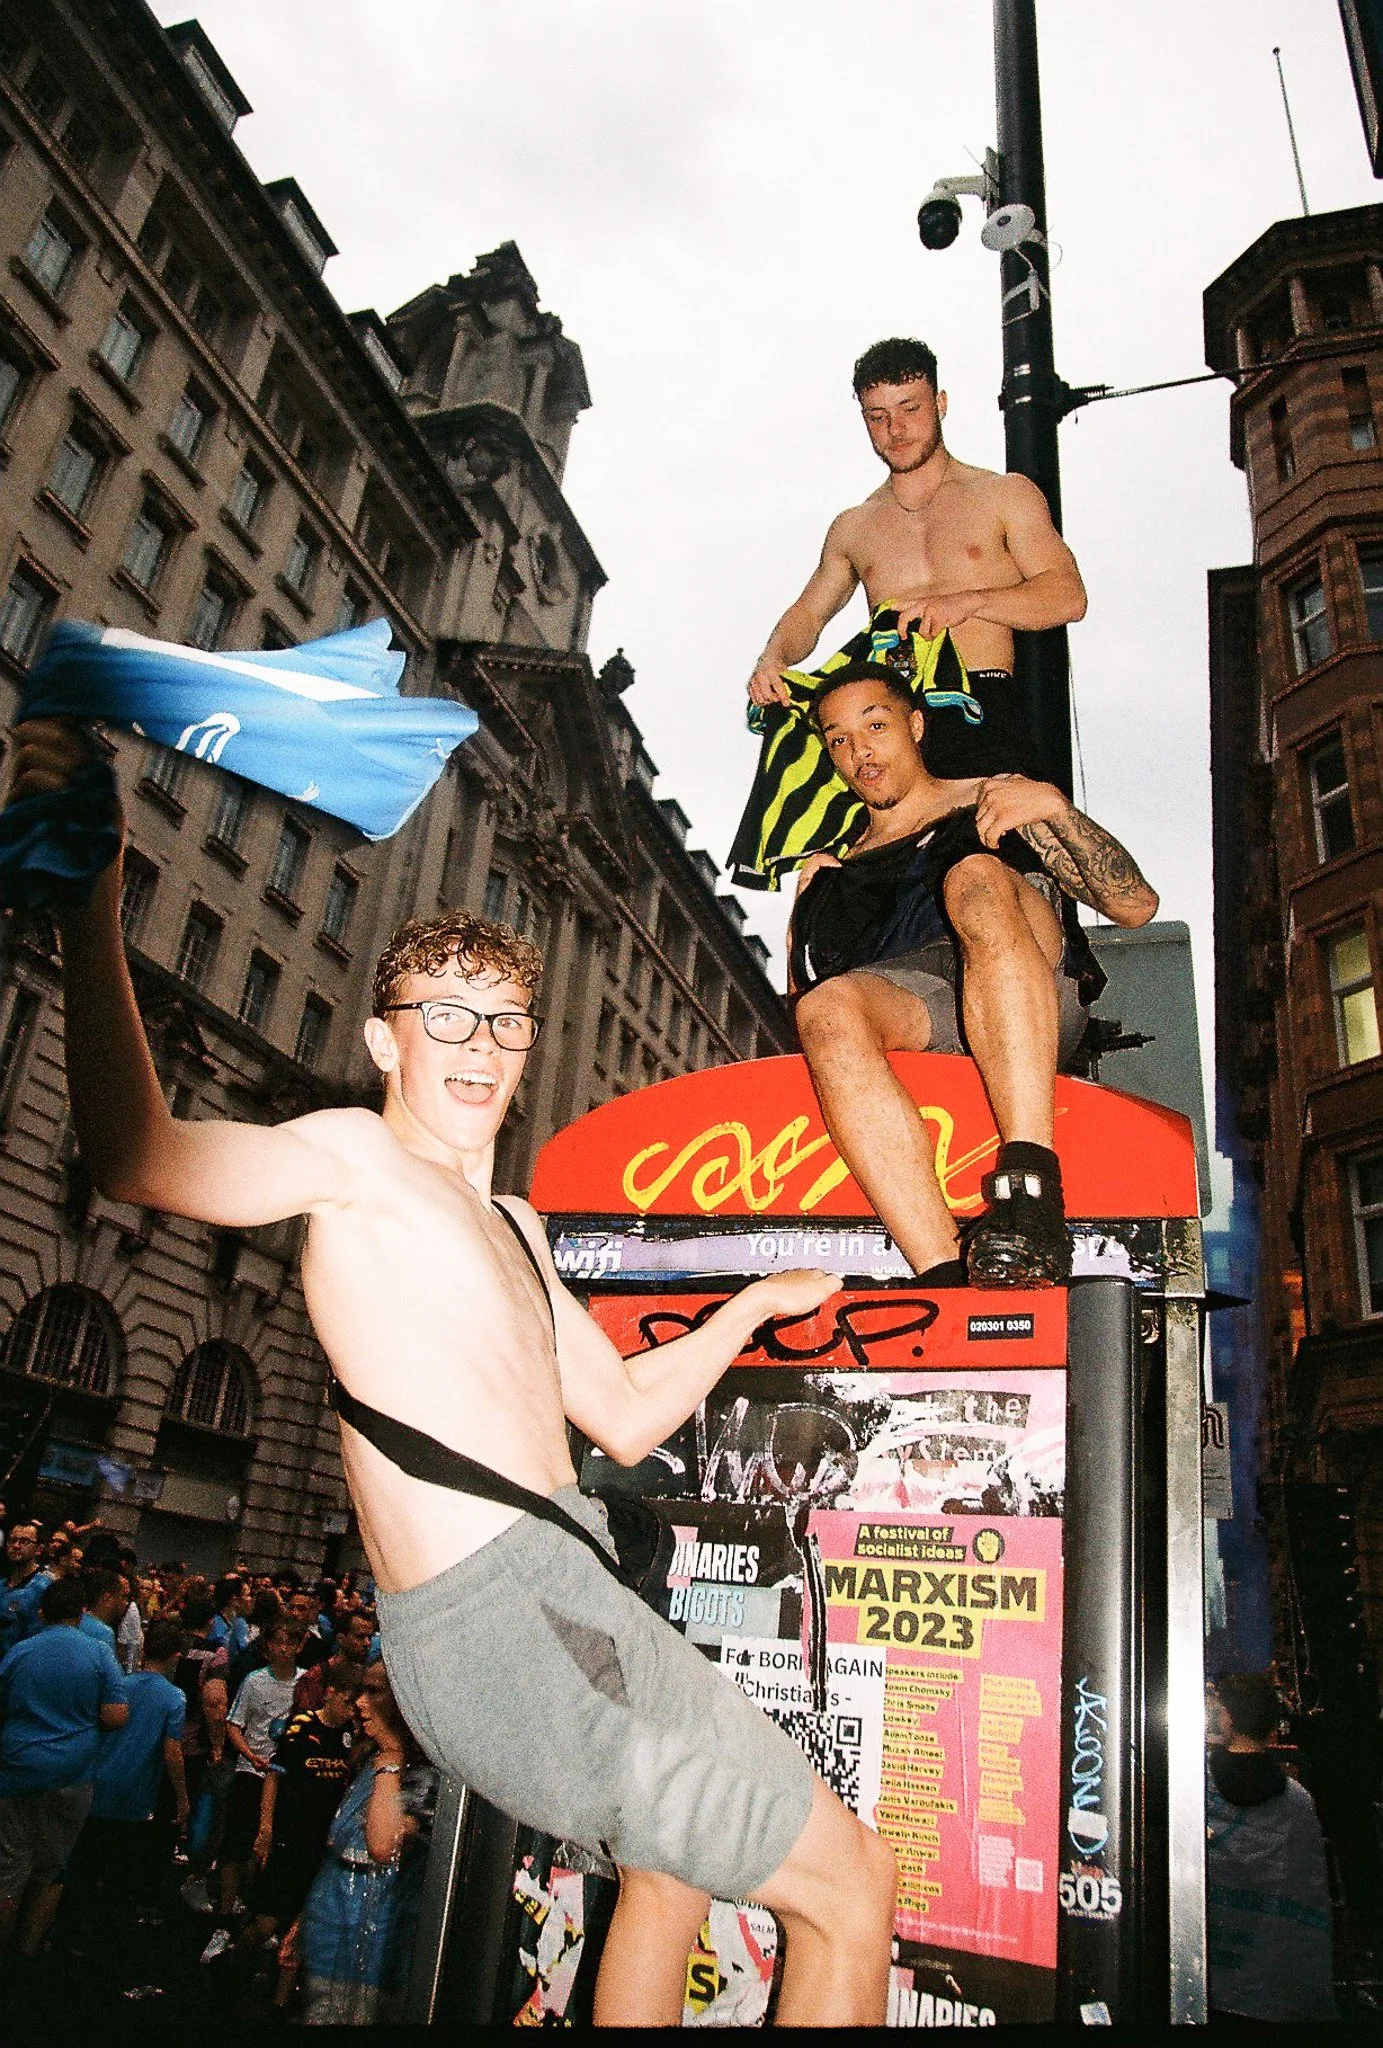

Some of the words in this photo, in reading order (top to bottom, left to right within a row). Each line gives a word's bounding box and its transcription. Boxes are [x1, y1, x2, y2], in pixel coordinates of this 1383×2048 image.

[747, 1231, 831, 1256] You're
[839, 1234, 865, 1256] in
[970, 1321, 1004, 1332] 020301
[1006, 1320, 1031, 1331] 0350
[860, 1525, 870, 1538] A
[873, 1525, 930, 1540] festival
[932, 1527, 949, 1541] of
[857, 1543, 918, 1558] socialist
[921, 1545, 964, 1560] ideas
[824, 1565, 1037, 1612] MARXISM
[669, 1586, 744, 1628] BIGOTS
[865, 1605, 974, 1651] 2023
[743, 1678, 840, 1706] Christias
[1059, 1872, 1122, 1914] 505
[689, 1962, 715, 2003] S
